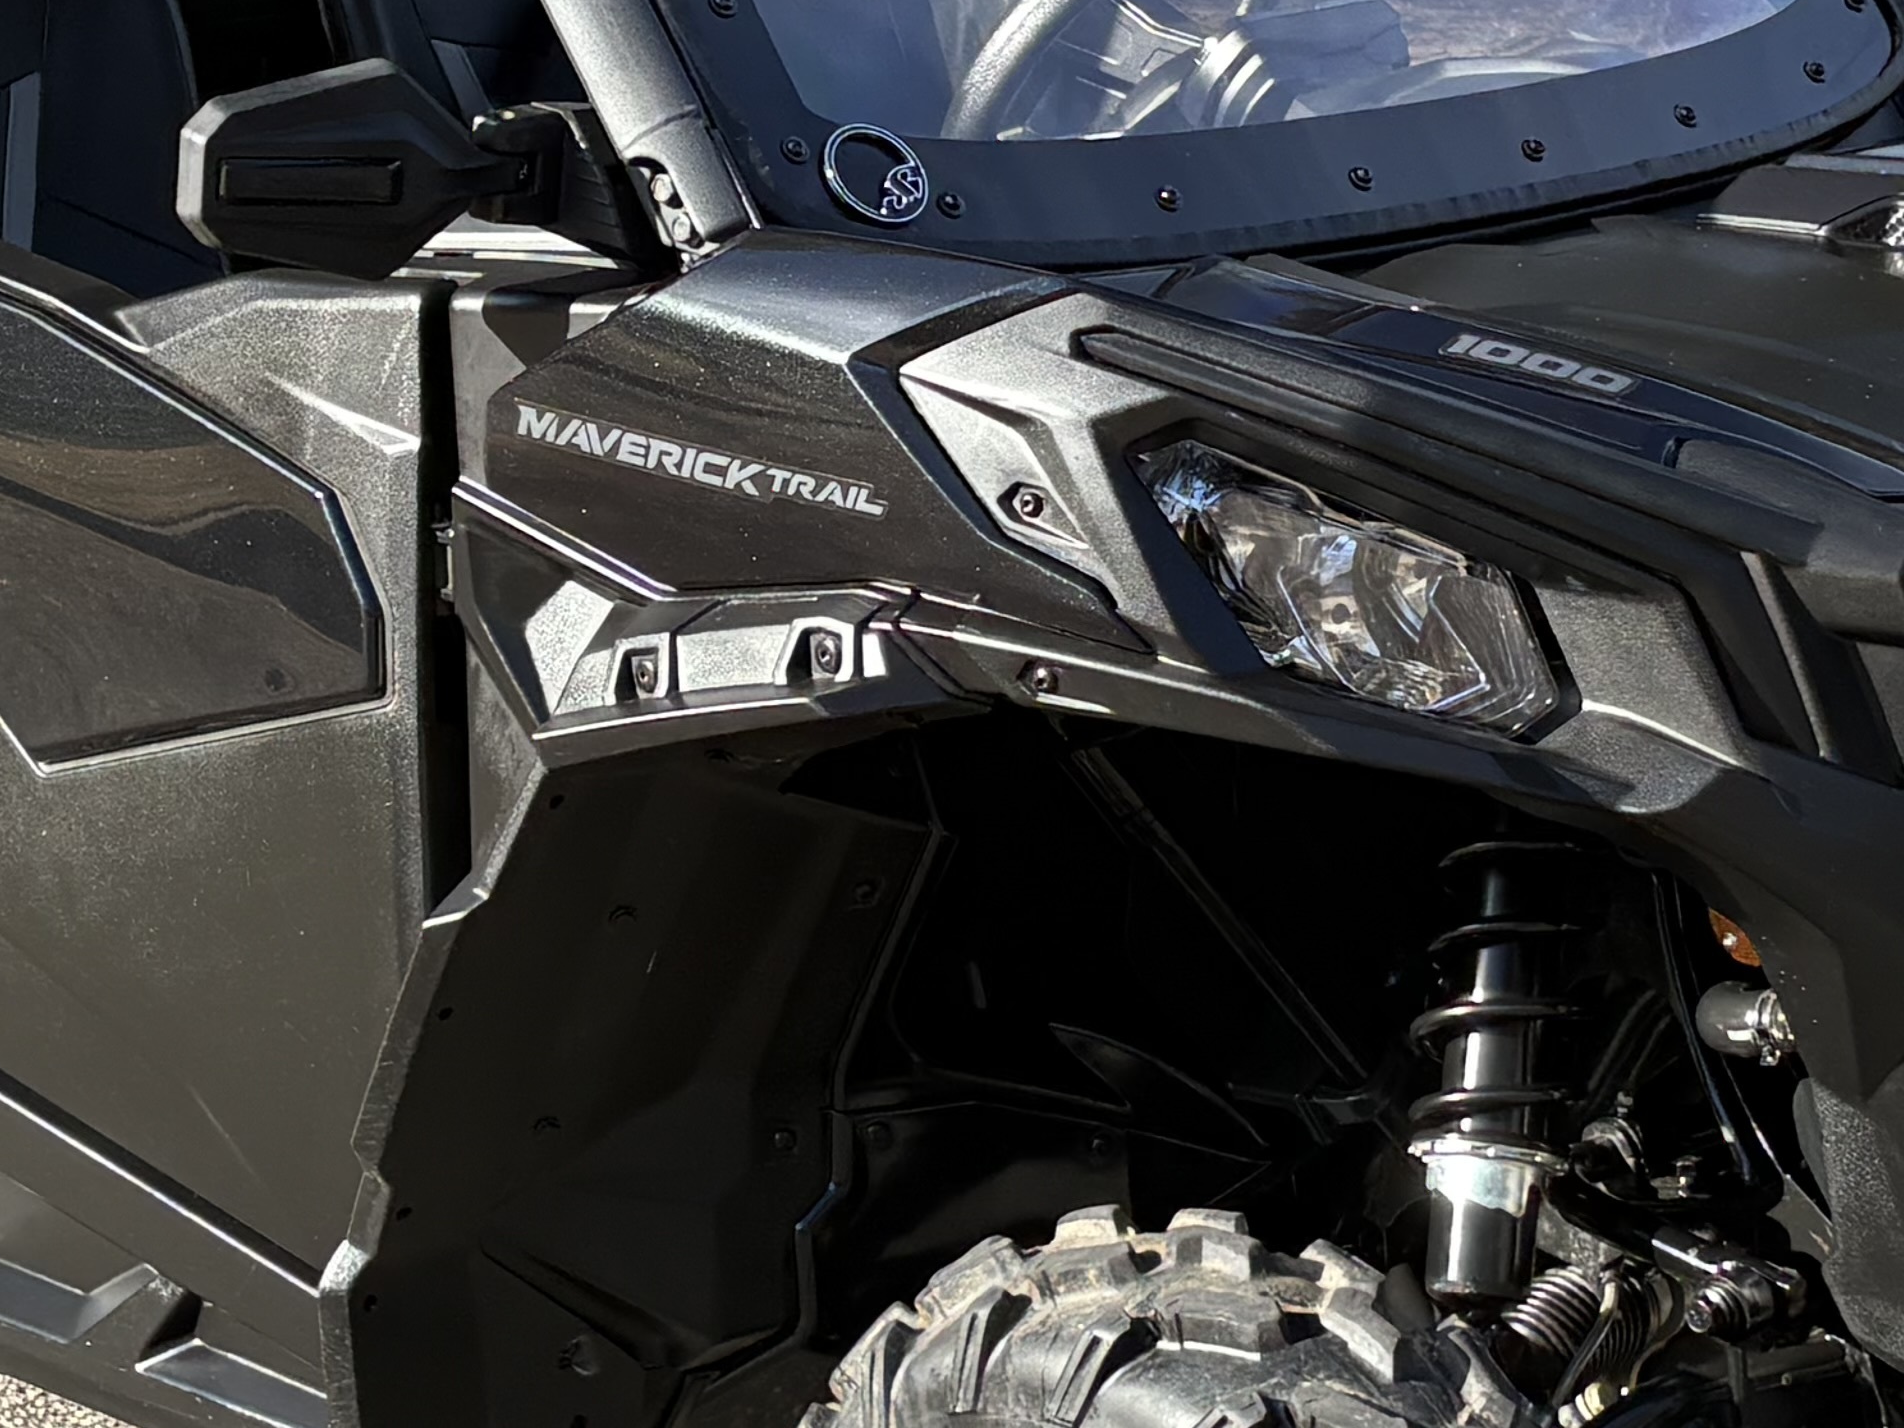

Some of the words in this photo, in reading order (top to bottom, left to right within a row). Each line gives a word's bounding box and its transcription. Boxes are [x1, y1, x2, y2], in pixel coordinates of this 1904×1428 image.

[1446, 334, 1635, 393] 1000
[516, 404, 764, 497] MAVERICK
[768, 467, 885, 516] TRAIL
